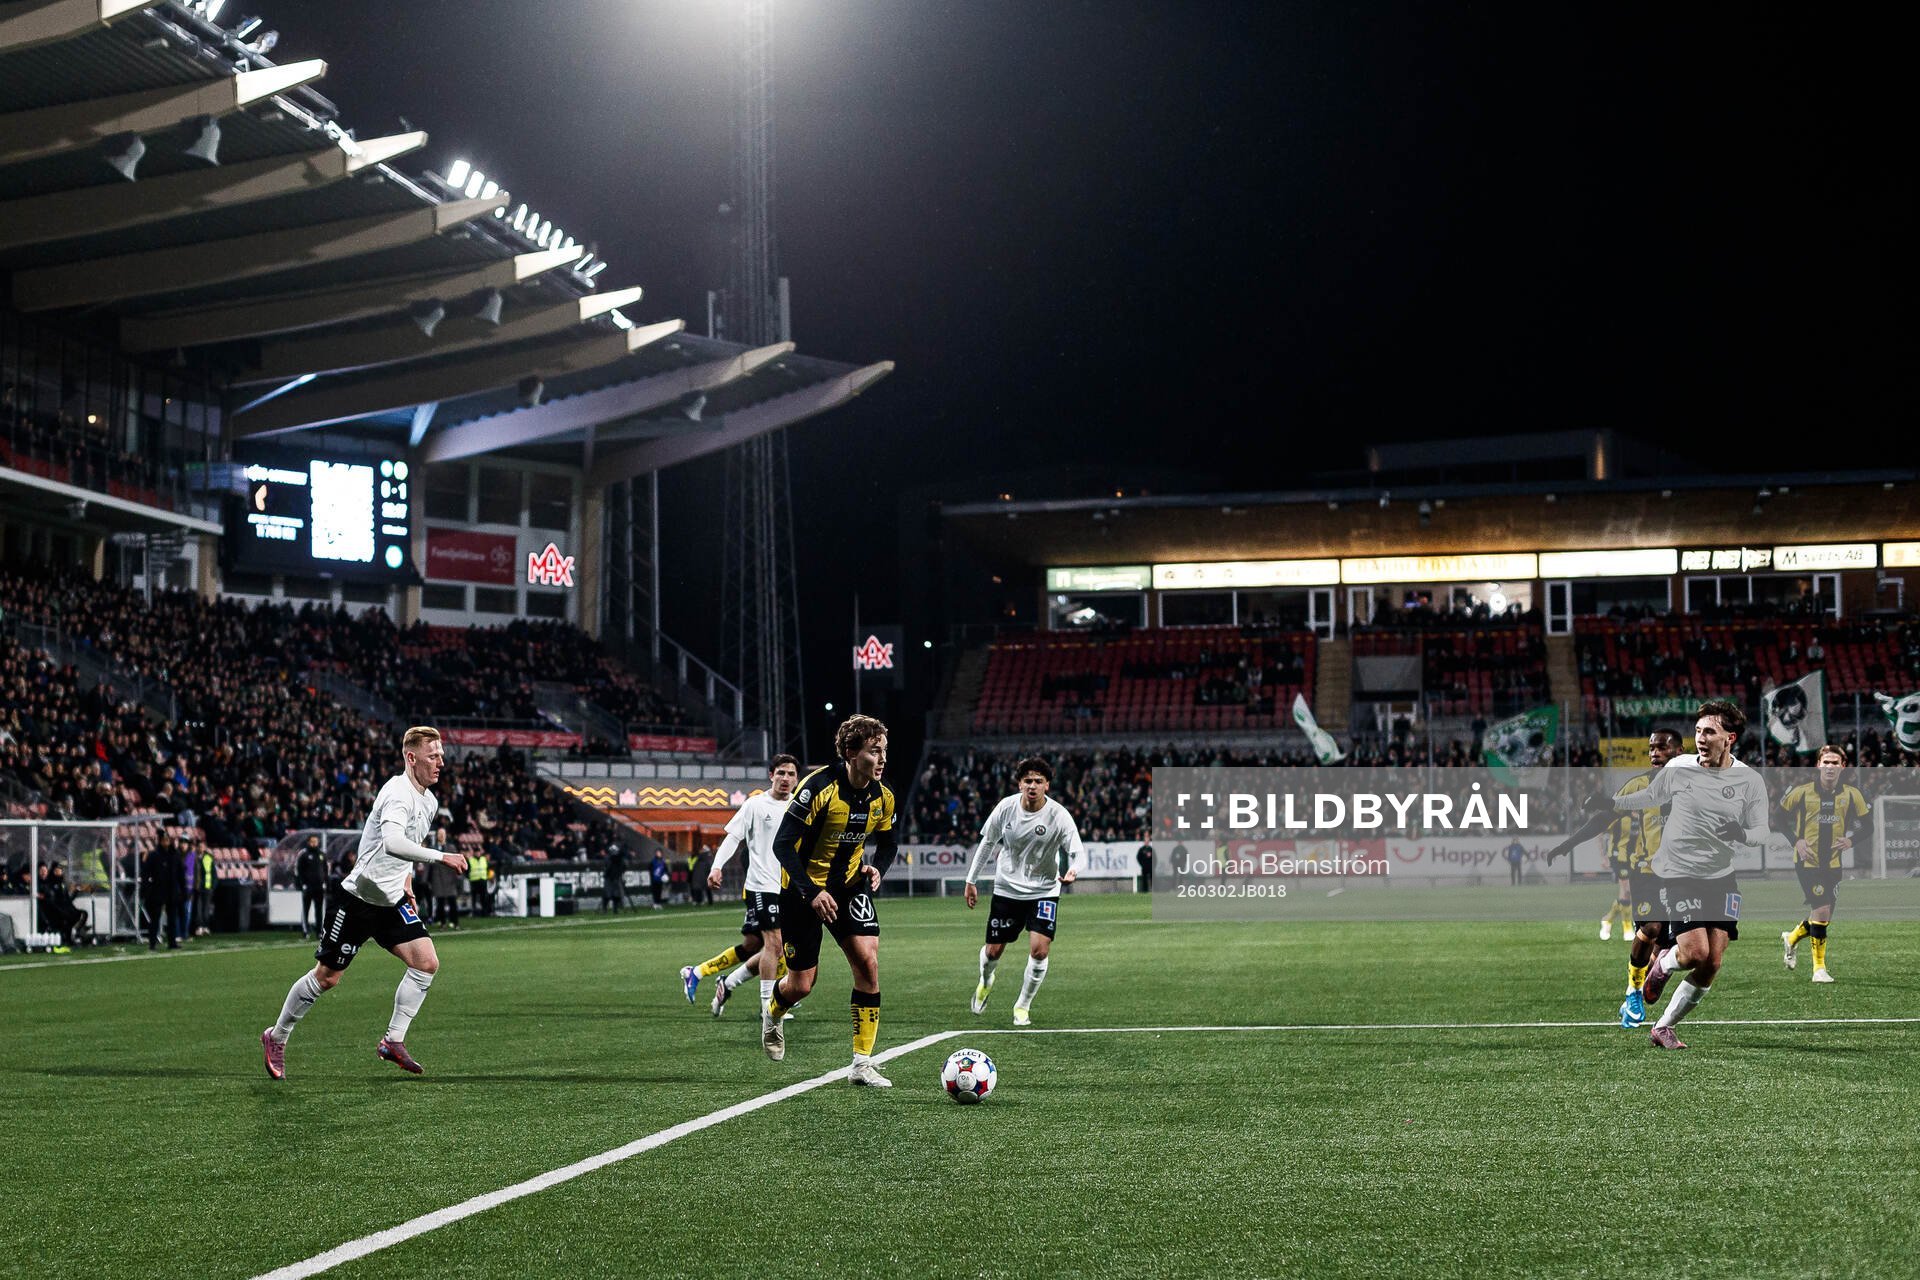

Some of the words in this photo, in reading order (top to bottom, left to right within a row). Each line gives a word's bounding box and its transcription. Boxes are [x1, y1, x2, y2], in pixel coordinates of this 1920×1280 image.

[528, 542, 575, 587] MAX
[853, 634, 894, 670] MAX
[920, 852, 967, 865] ICON
[1432, 846, 1497, 866] Happy
[1682, 914, 1692, 924] 27
[952, 1051, 982, 1059] SELECT
